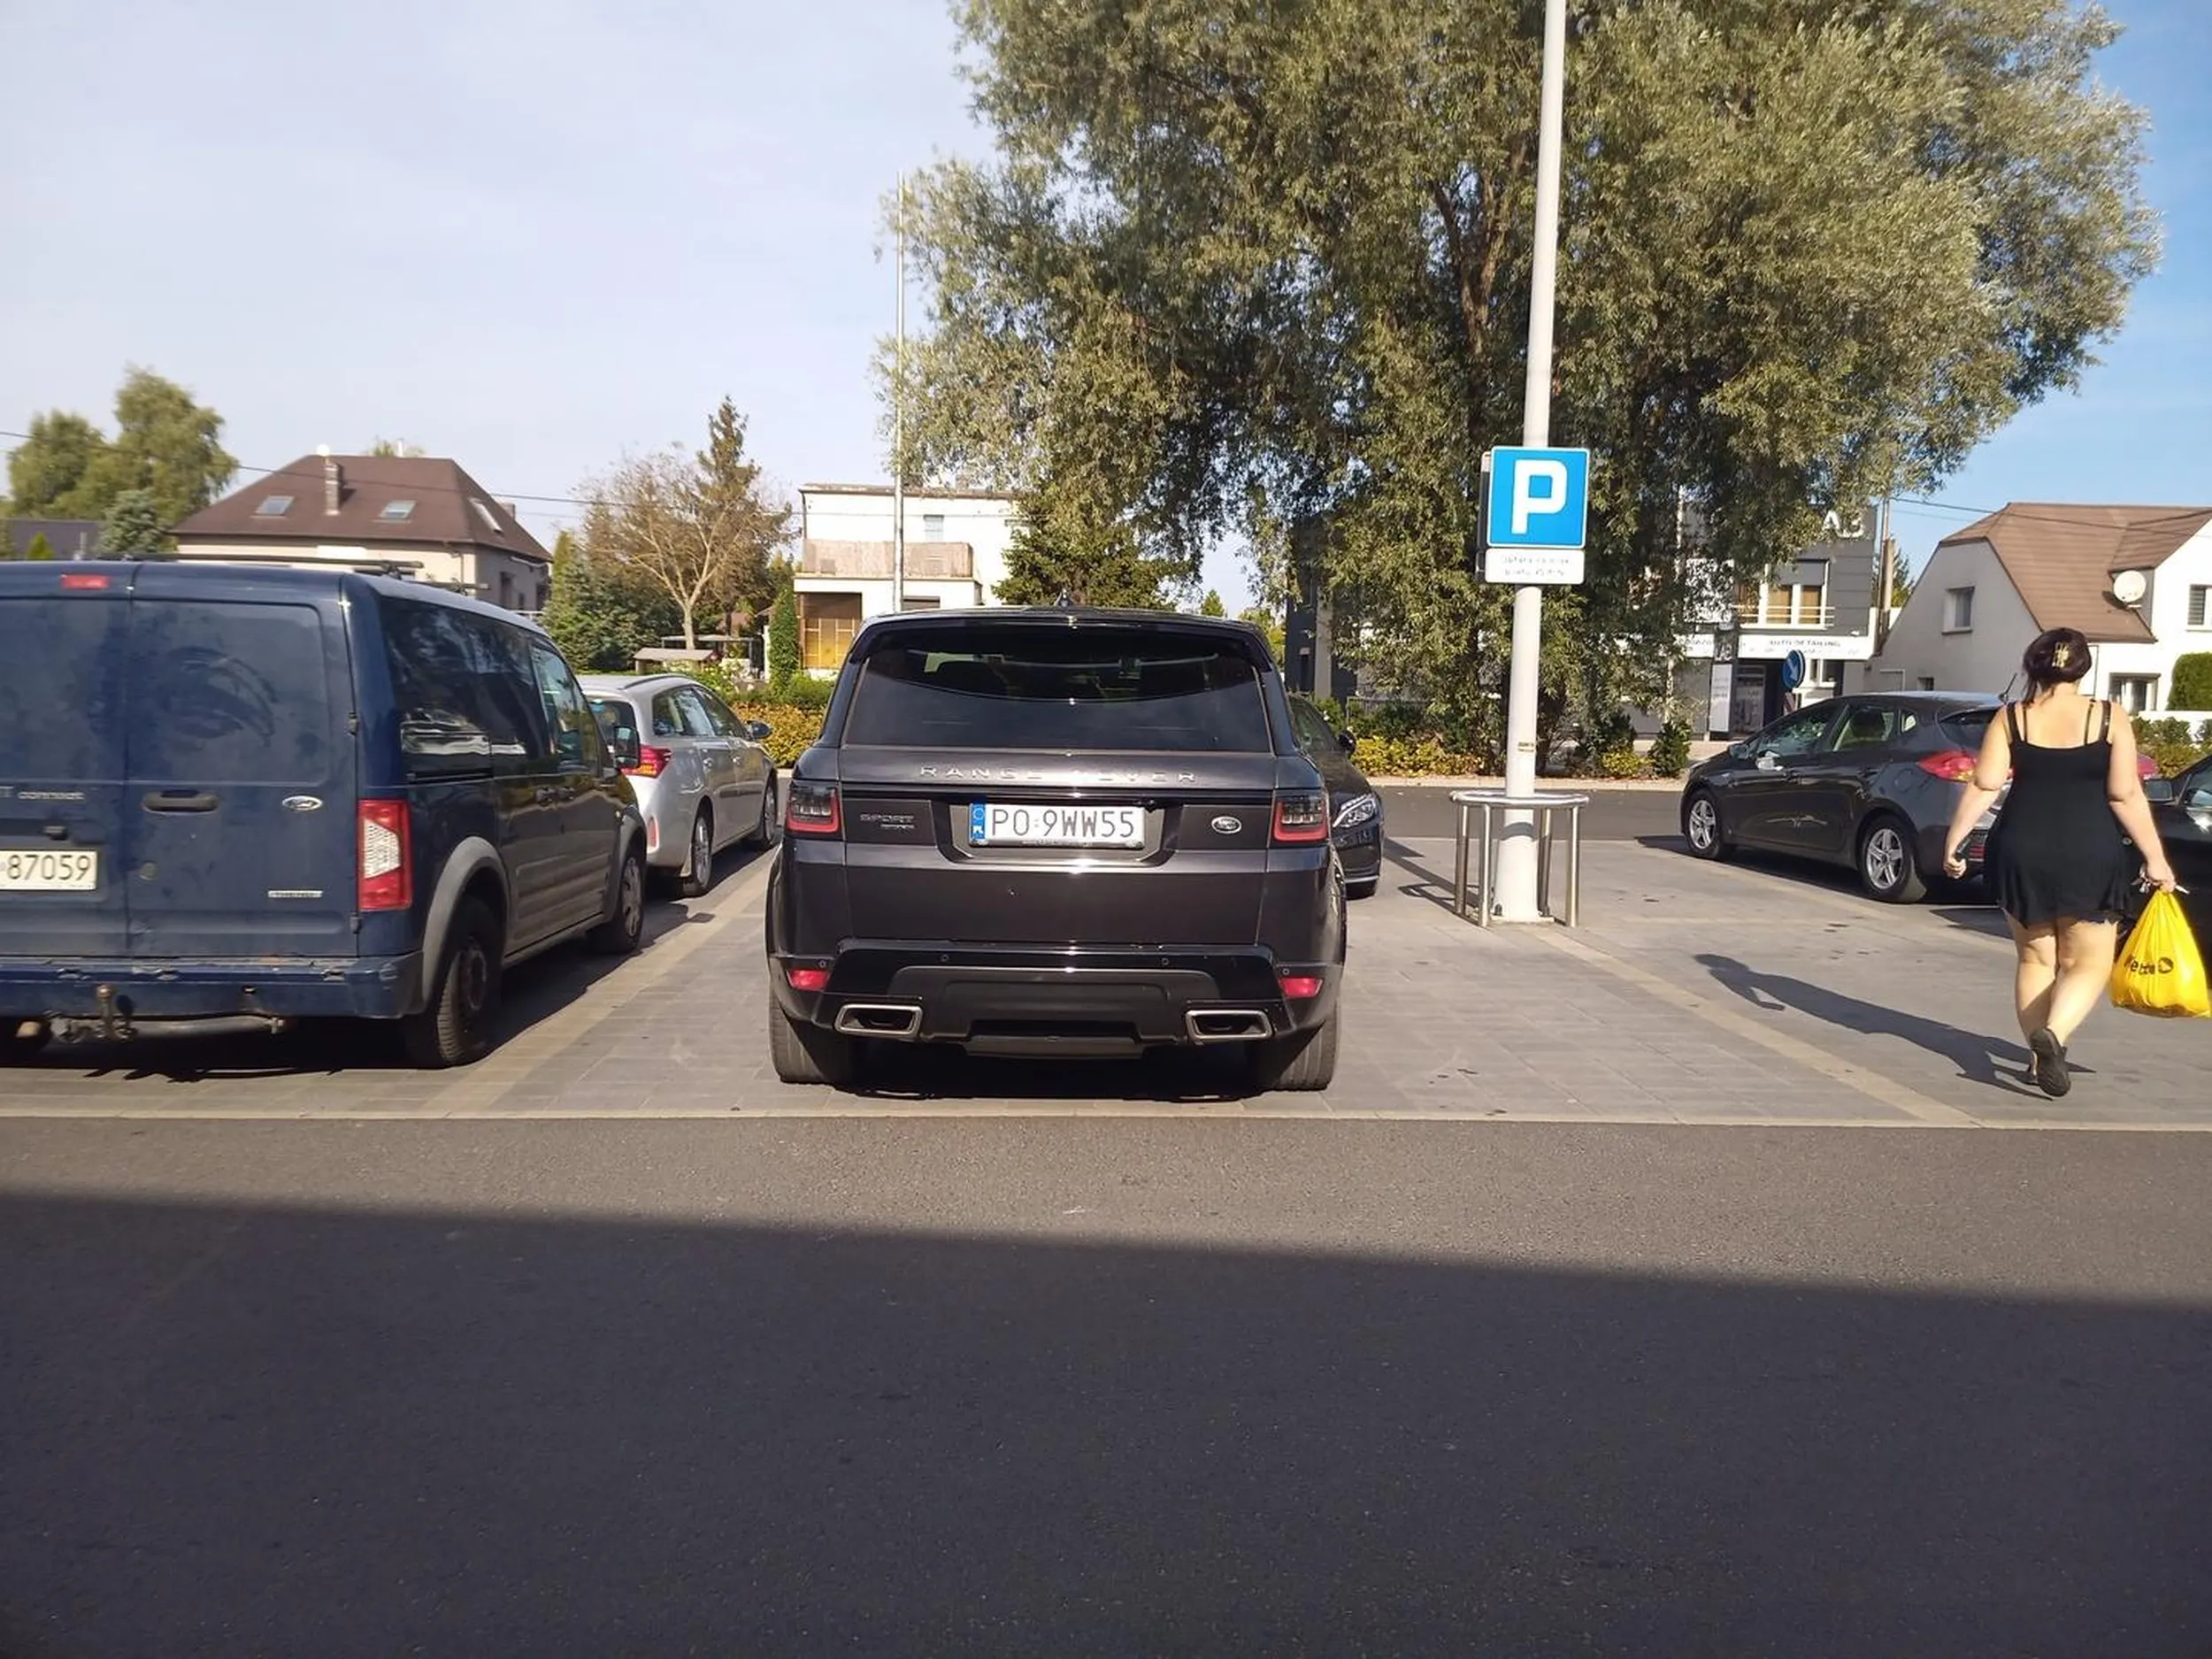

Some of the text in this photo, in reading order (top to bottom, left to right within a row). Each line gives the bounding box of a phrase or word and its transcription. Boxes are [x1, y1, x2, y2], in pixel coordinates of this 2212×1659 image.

[1511, 459, 1567, 534] P
[920, 766, 1043, 780] RANGE
[1043, 809, 1134, 838] 9WW55
[7, 854, 91, 881] 87059
